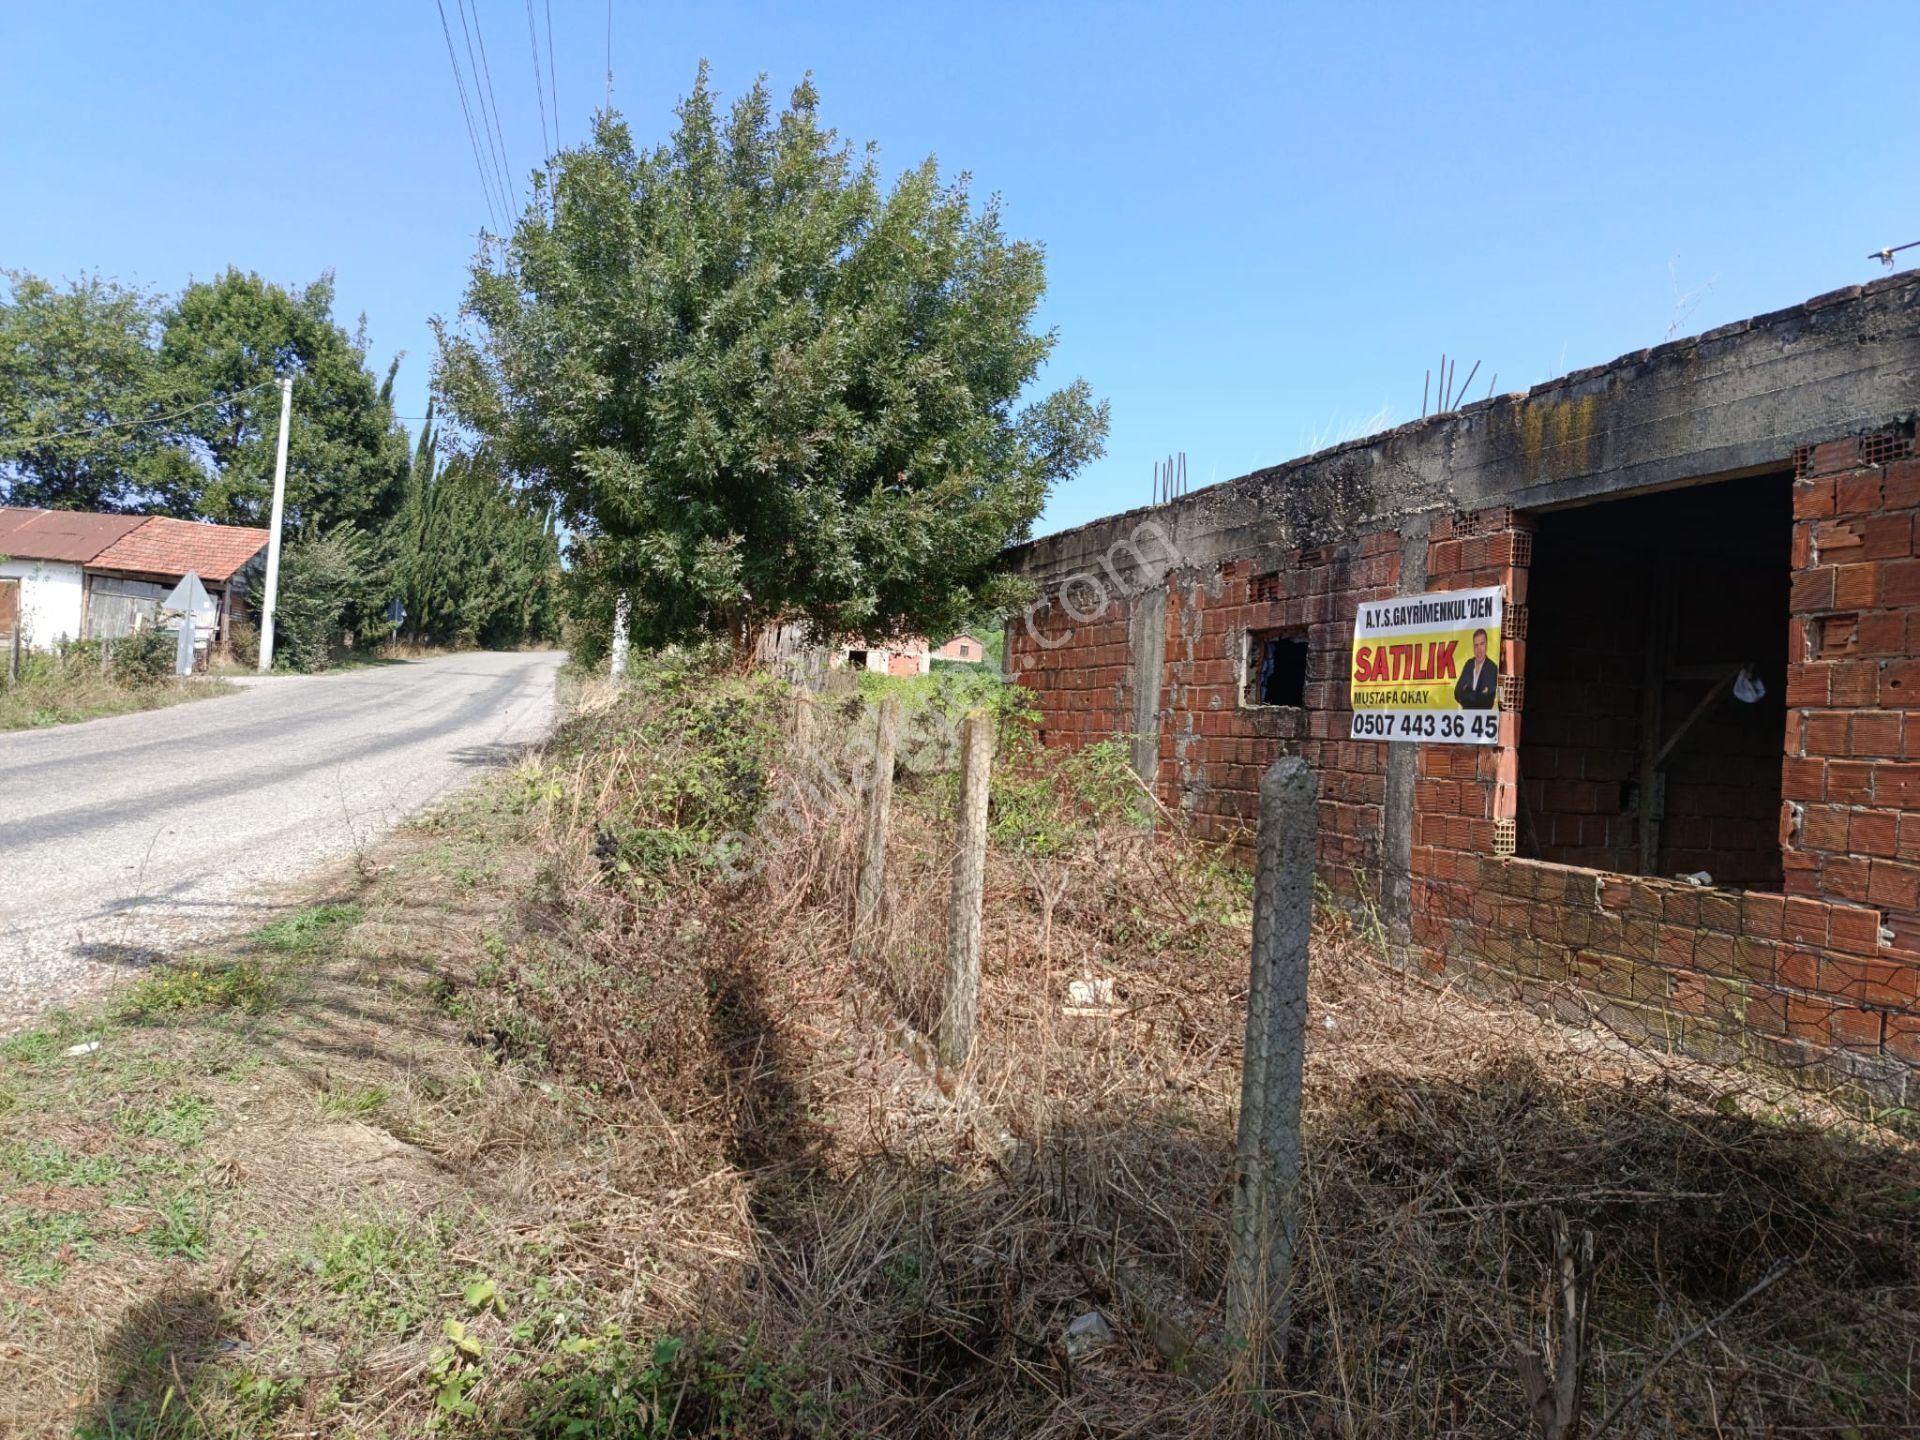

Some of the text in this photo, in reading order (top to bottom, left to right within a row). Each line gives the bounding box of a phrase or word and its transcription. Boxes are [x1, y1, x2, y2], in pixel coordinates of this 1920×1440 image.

[1354, 640, 1459, 683] SATILIK
[1354, 690, 1430, 705] MUSTAFA OKAY
[1353, 714, 1497, 739] 0507 443 36 45
